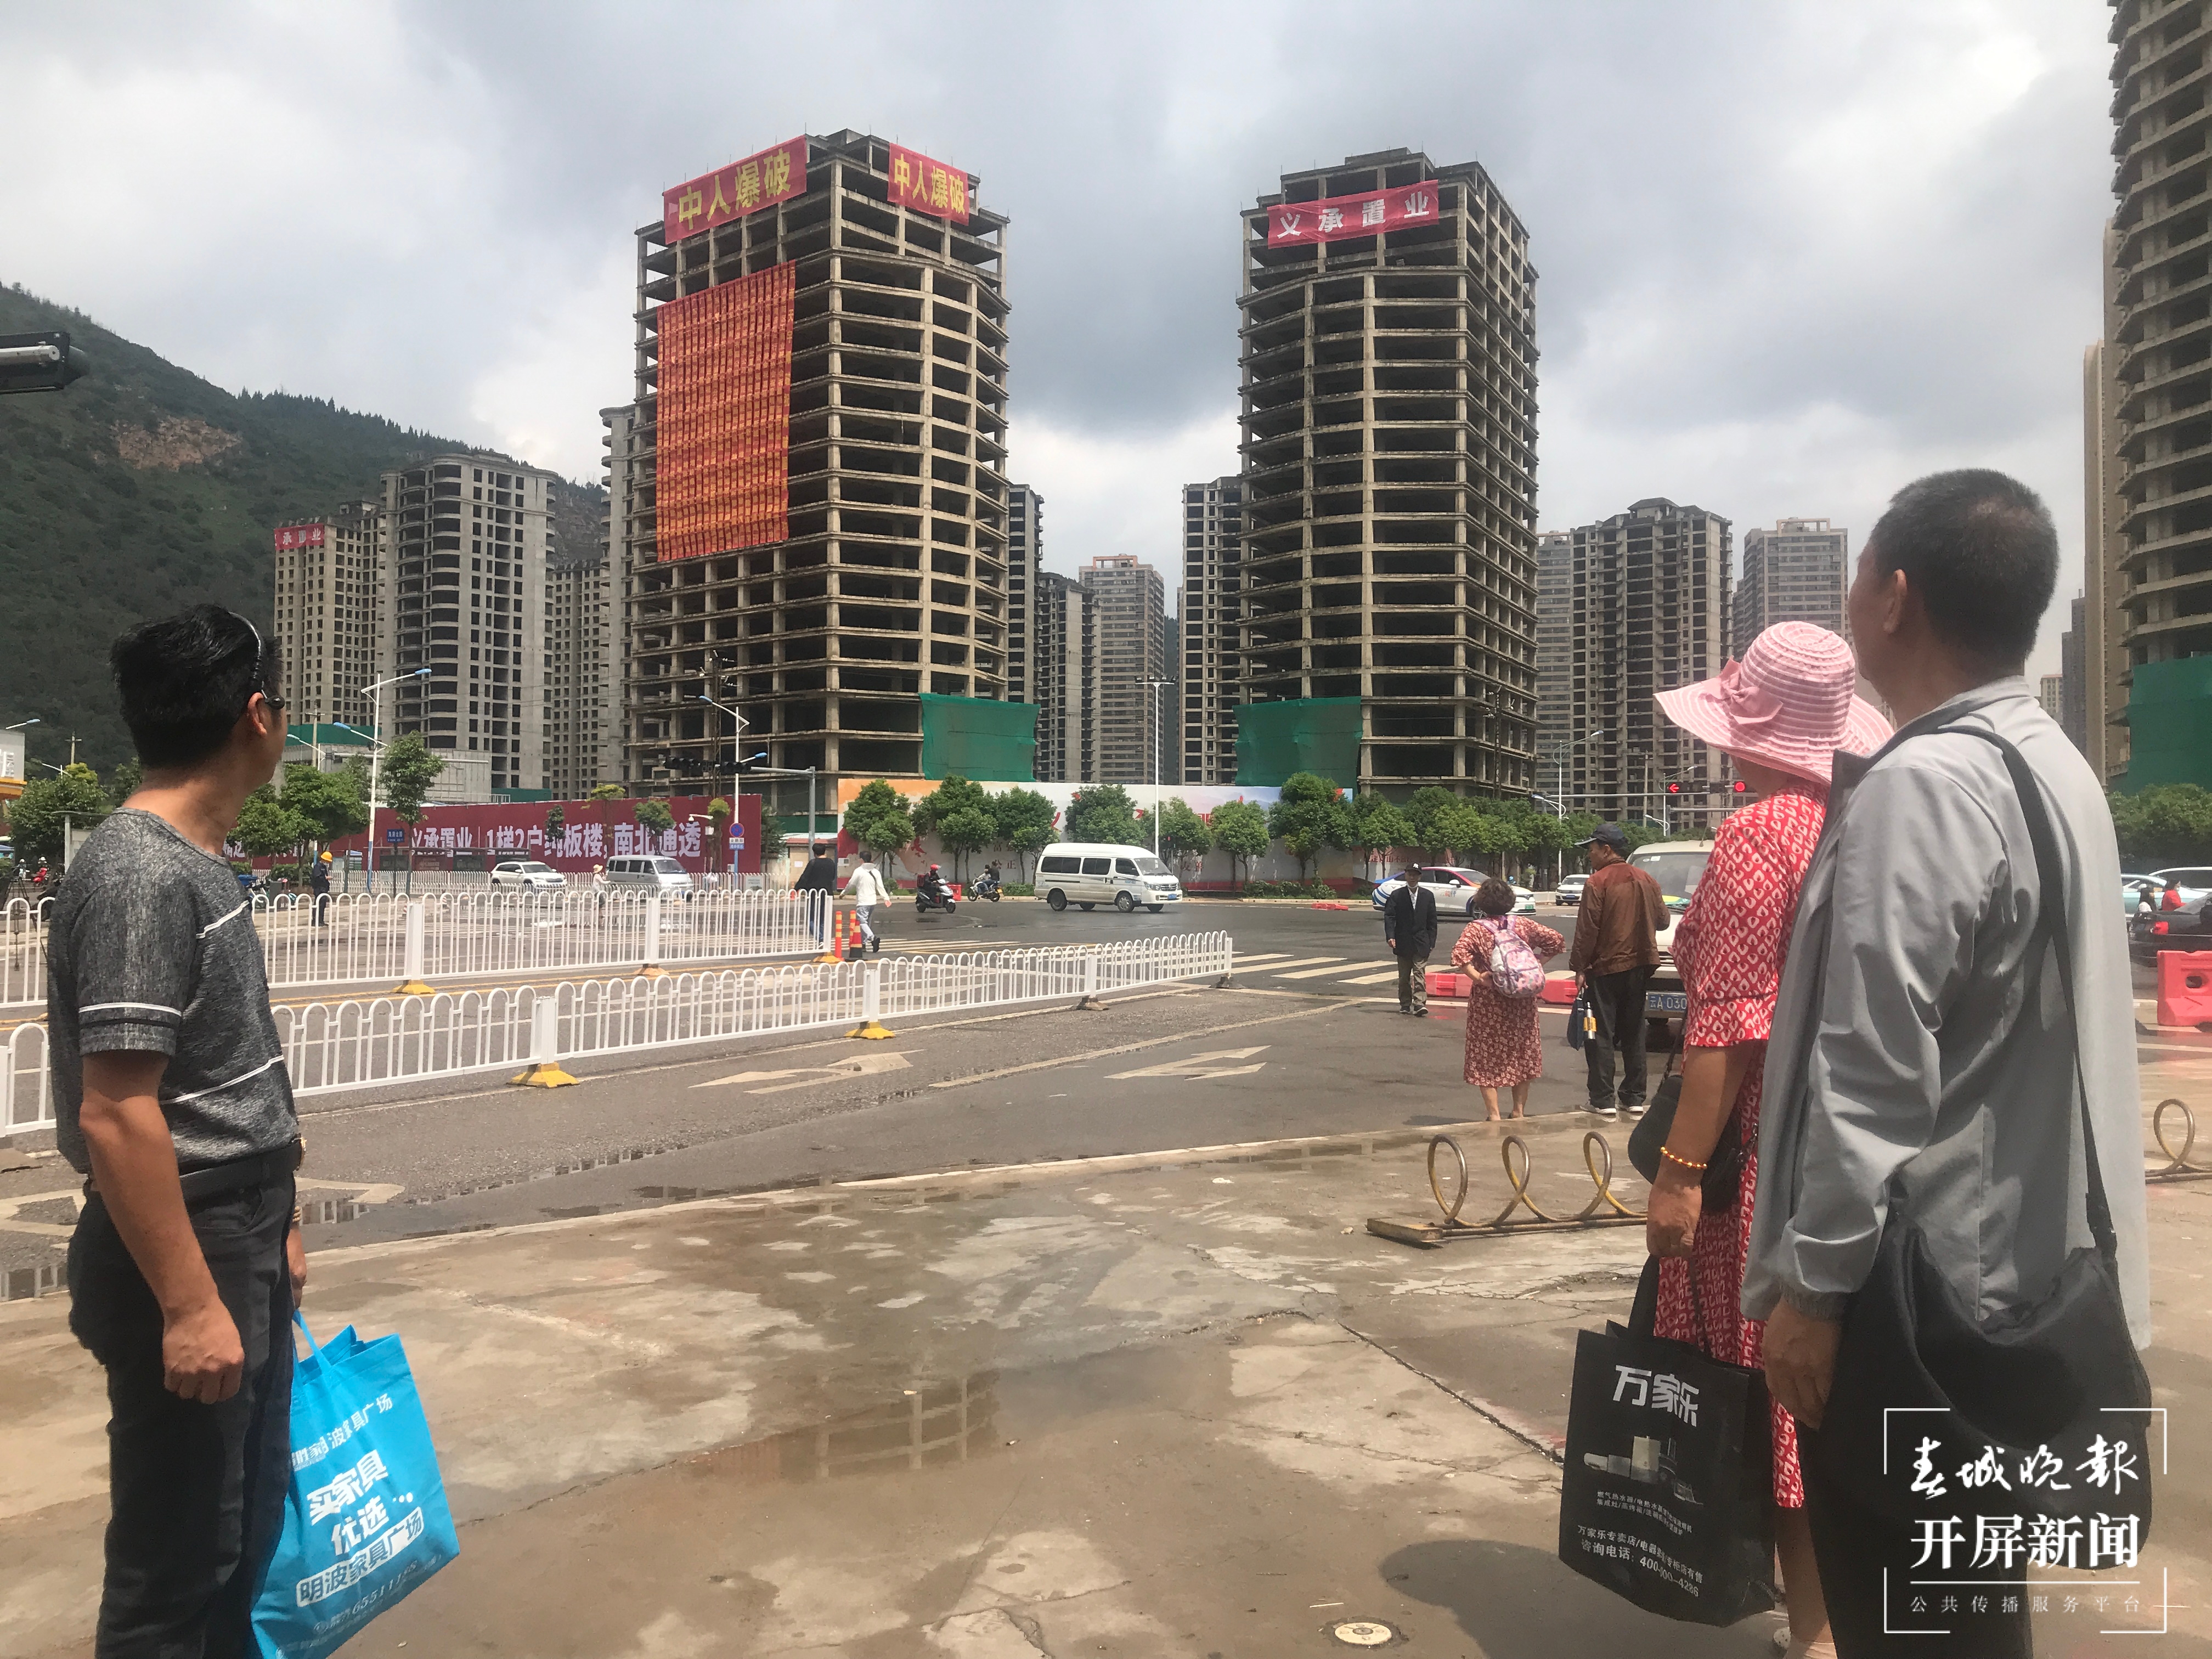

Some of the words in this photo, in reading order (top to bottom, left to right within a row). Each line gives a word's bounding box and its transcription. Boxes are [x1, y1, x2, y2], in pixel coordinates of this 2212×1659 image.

[678, 148, 791, 230] 中人爆破
[894, 153, 966, 215] 中人爆破
[1276, 191, 1430, 239] 义承置业
[1612, 1364, 1700, 1427] 万家乐
[306, 1449, 389, 1526] 买家具
[299, 1513, 424, 1604] 明波家具广场
